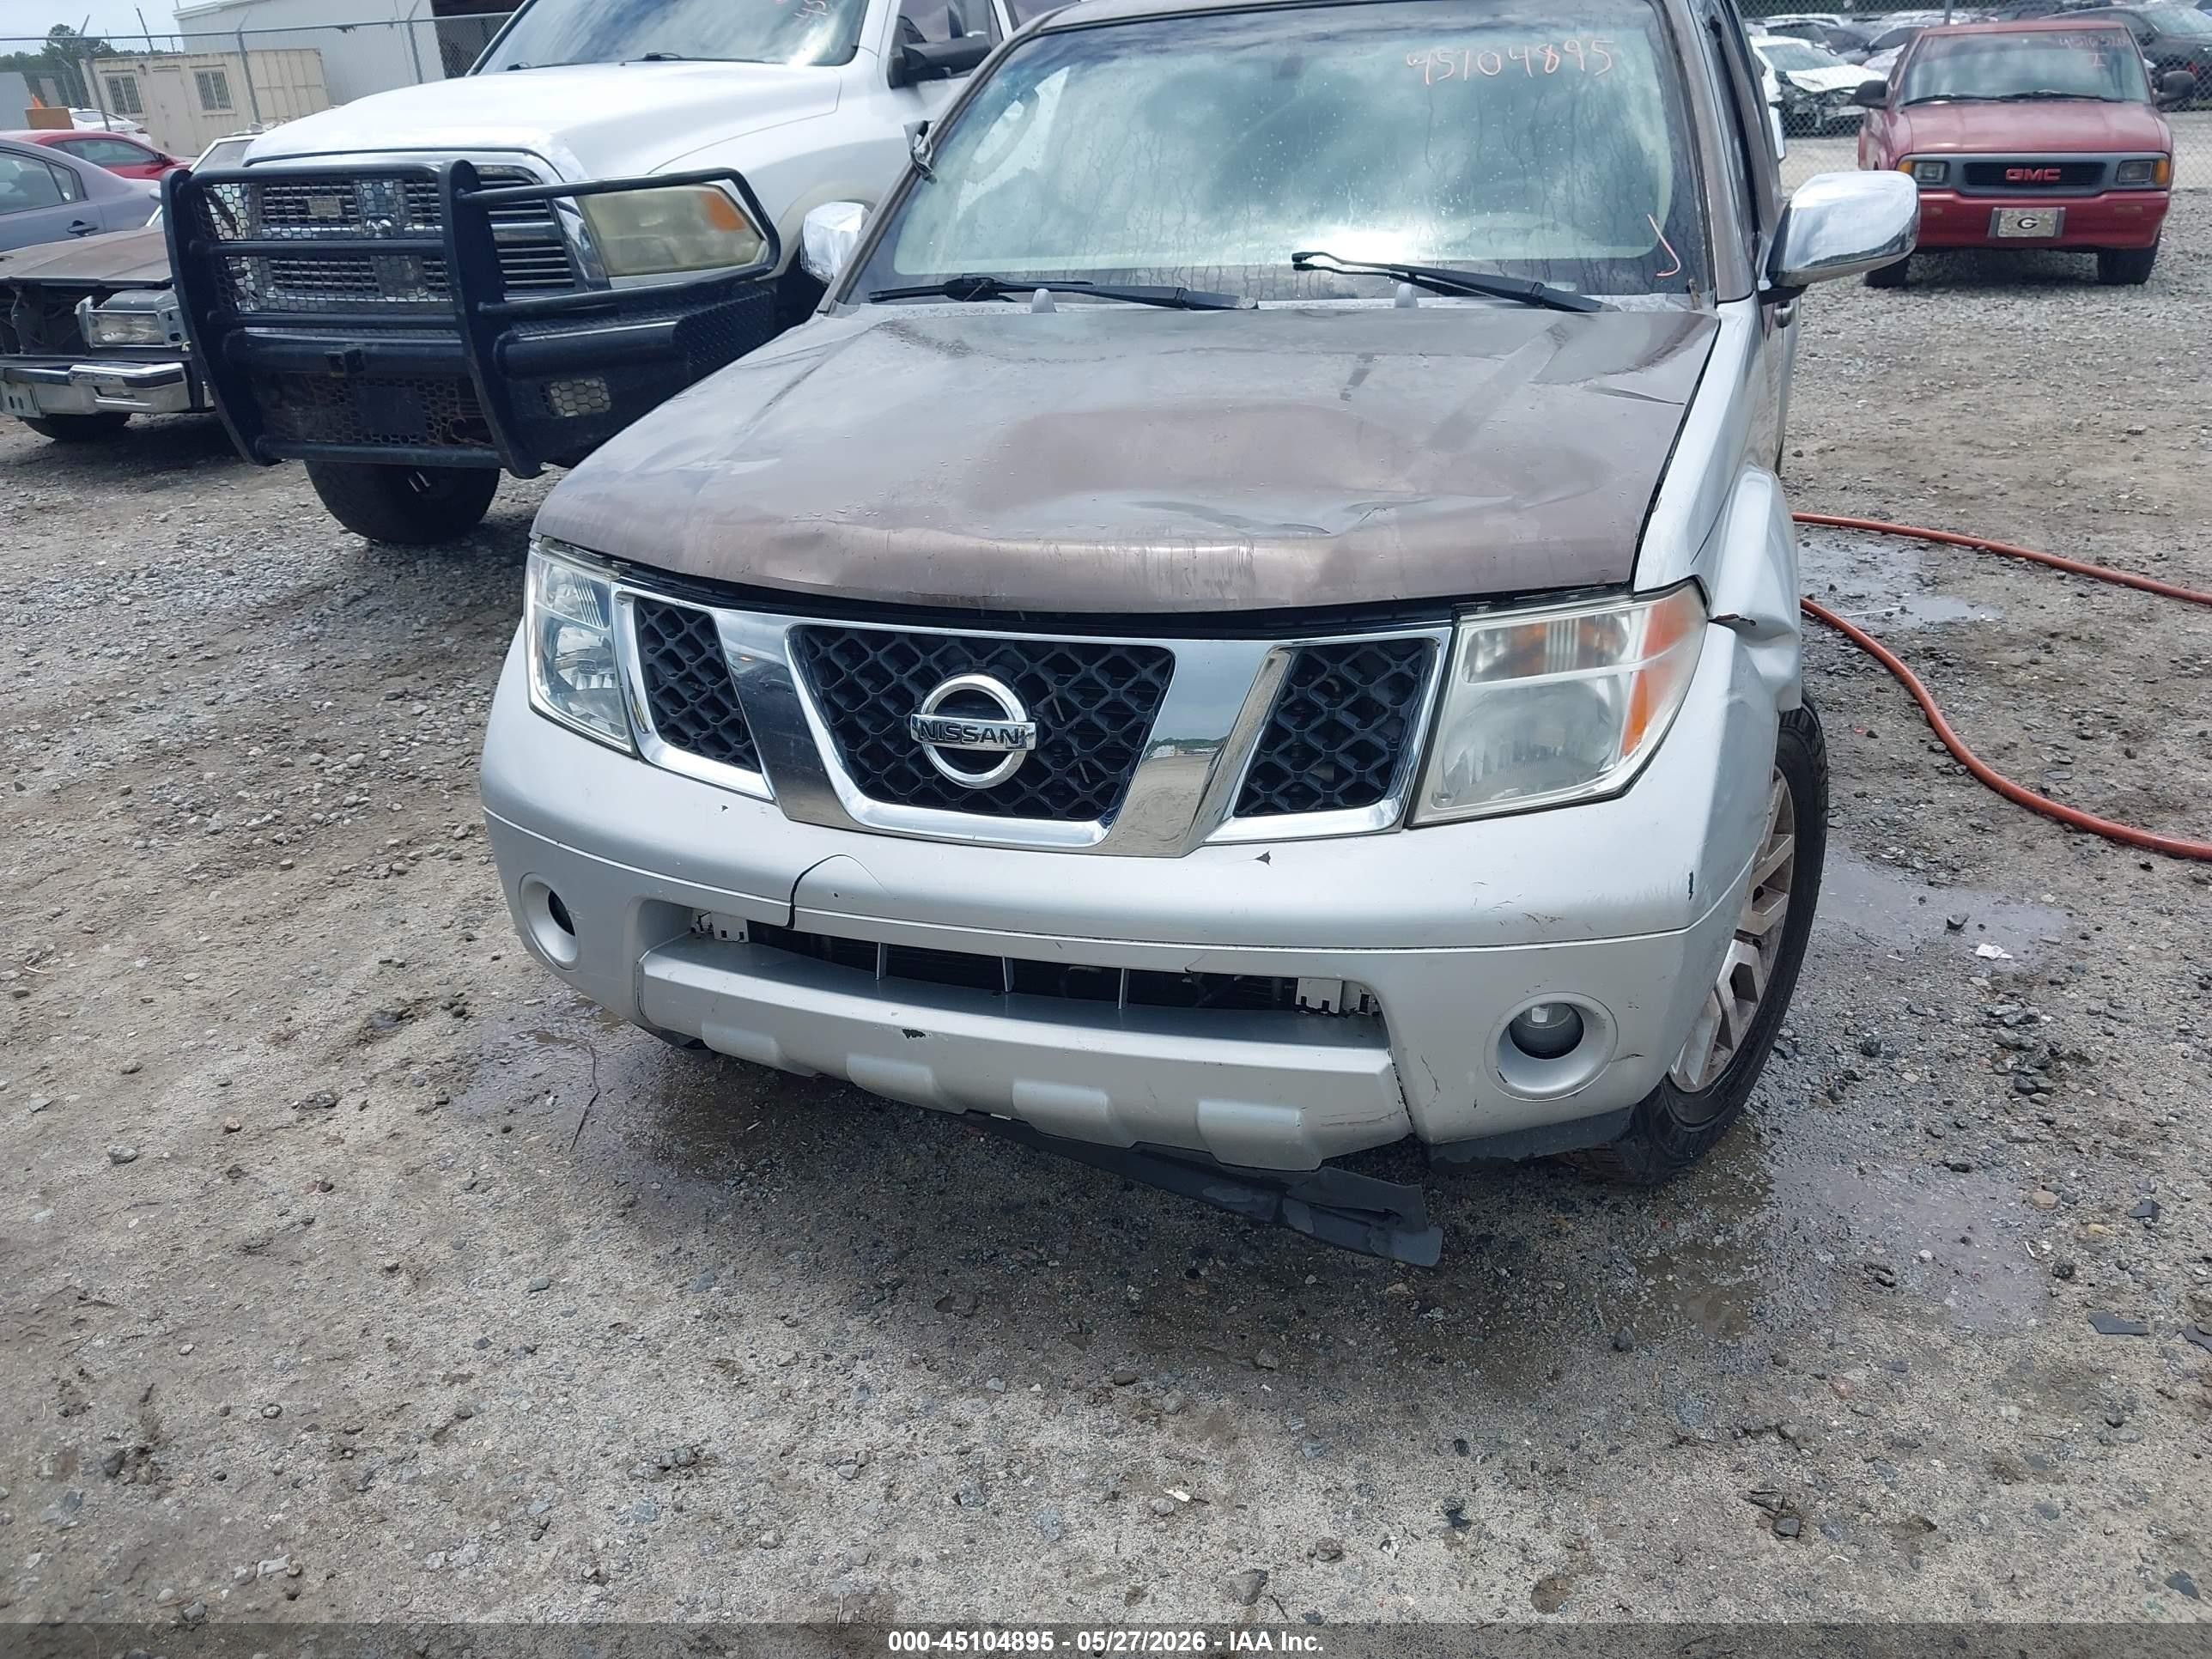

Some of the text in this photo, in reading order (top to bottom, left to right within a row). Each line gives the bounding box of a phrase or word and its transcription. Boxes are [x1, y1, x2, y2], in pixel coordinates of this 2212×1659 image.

[1407, 40, 1614, 85] 45104895
[2006, 168, 2061, 181] GMC
[2017, 216, 2038, 229] G
[919, 720, 1020, 746] NISSAN
